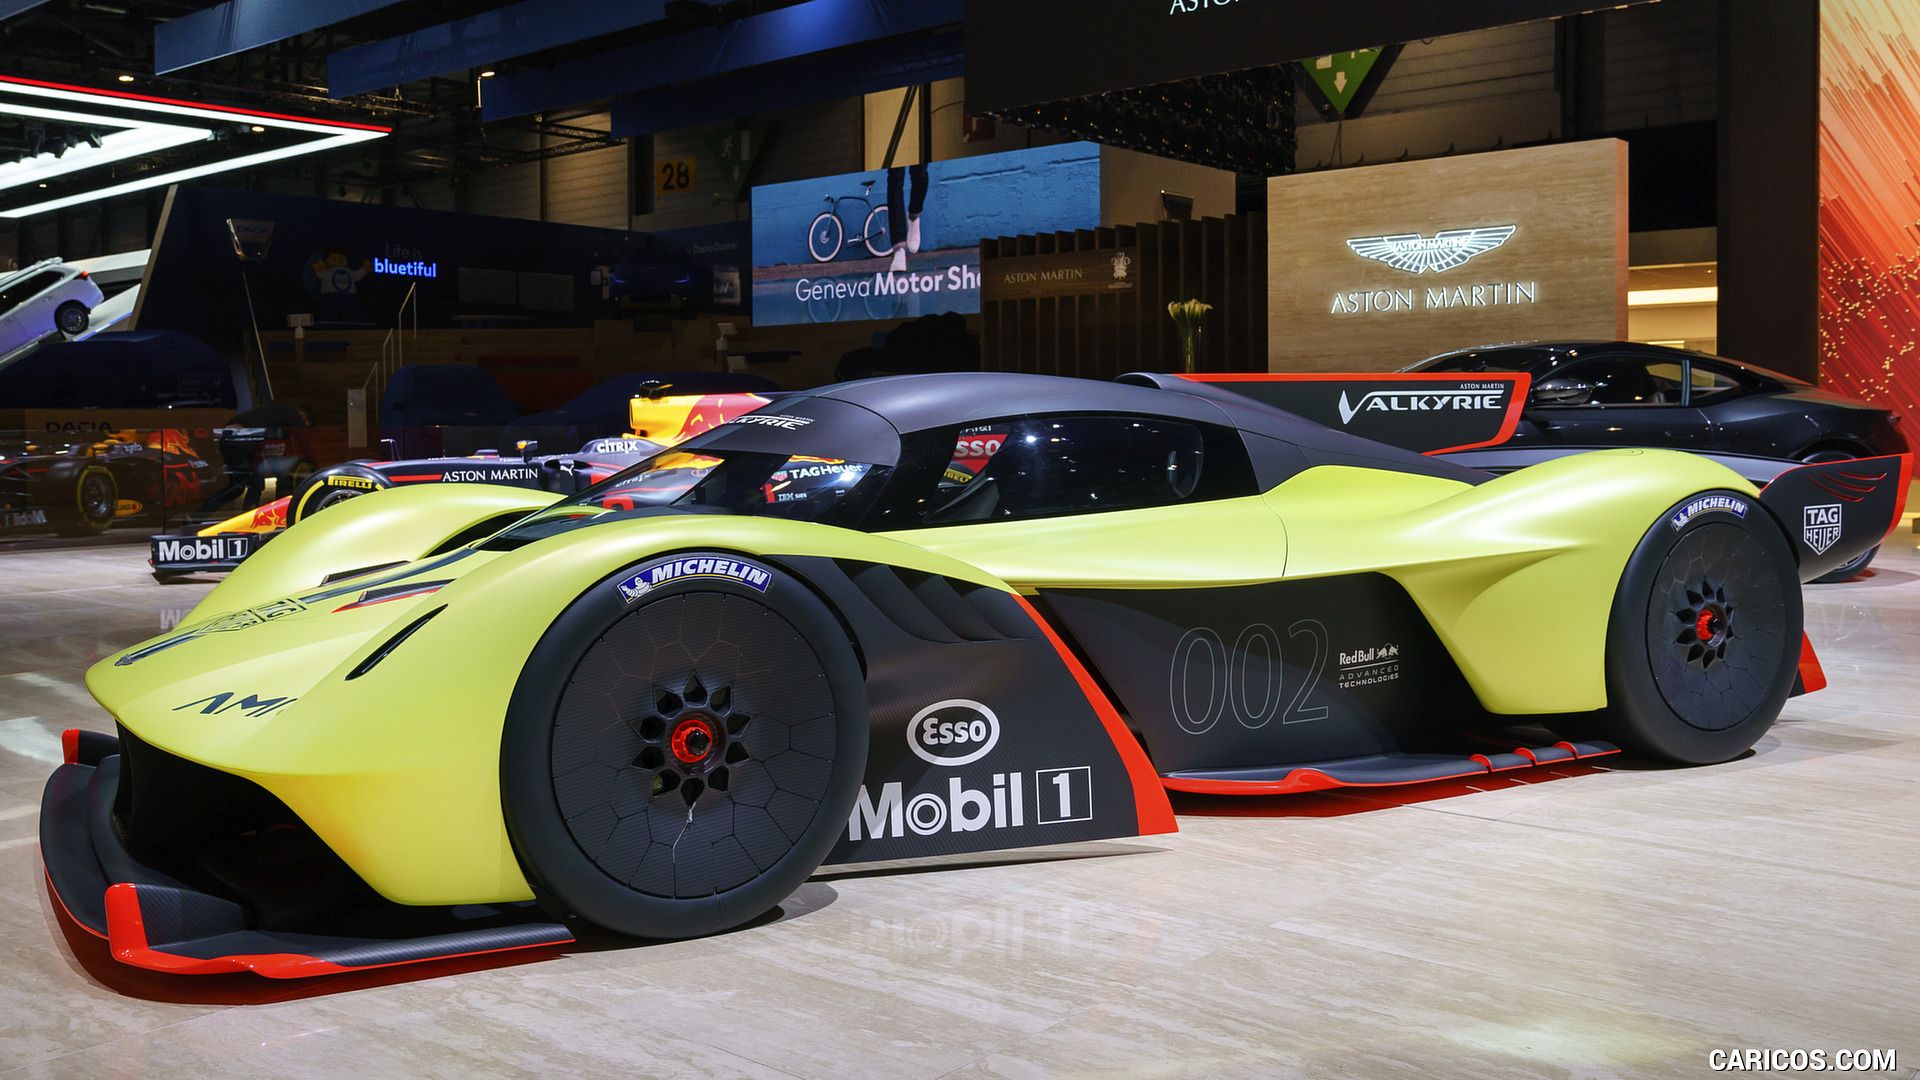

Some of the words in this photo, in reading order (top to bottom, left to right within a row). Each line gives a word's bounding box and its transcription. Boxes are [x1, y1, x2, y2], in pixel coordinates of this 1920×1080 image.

[662, 163, 690, 190] 28
[374, 257, 437, 278] bluetiful
[1004, 272, 1037, 284] ASTON
[1040, 268, 1082, 281] MARTIN
[796, 278, 870, 301] Geneva
[874, 272, 943, 296] Motor
[1330, 288, 1413, 314] ASTON
[1425, 281, 1536, 309] MARTIN
[1338, 390, 1504, 425] VALKYRIE
[46, 422, 112, 433] DACIA
[328, 475, 372, 489] PIRELLI
[442, 470, 485, 482] ASTON
[491, 468, 538, 480] MARTIN
[1687, 497, 1745, 517] MICHELIN
[1807, 507, 1839, 525] TAG
[1806, 526, 1839, 550] HEUER
[159, 539, 224, 561] Mobil
[652, 559, 768, 586] MICHELIN
[1170, 618, 1328, 735] 002
[1339, 664, 1399, 681] ADVANCED
[1339, 672, 1399, 688] TECHNOLOGIES
[848, 771, 1024, 842] Mobil
[1052, 772, 1071, 818] 1
